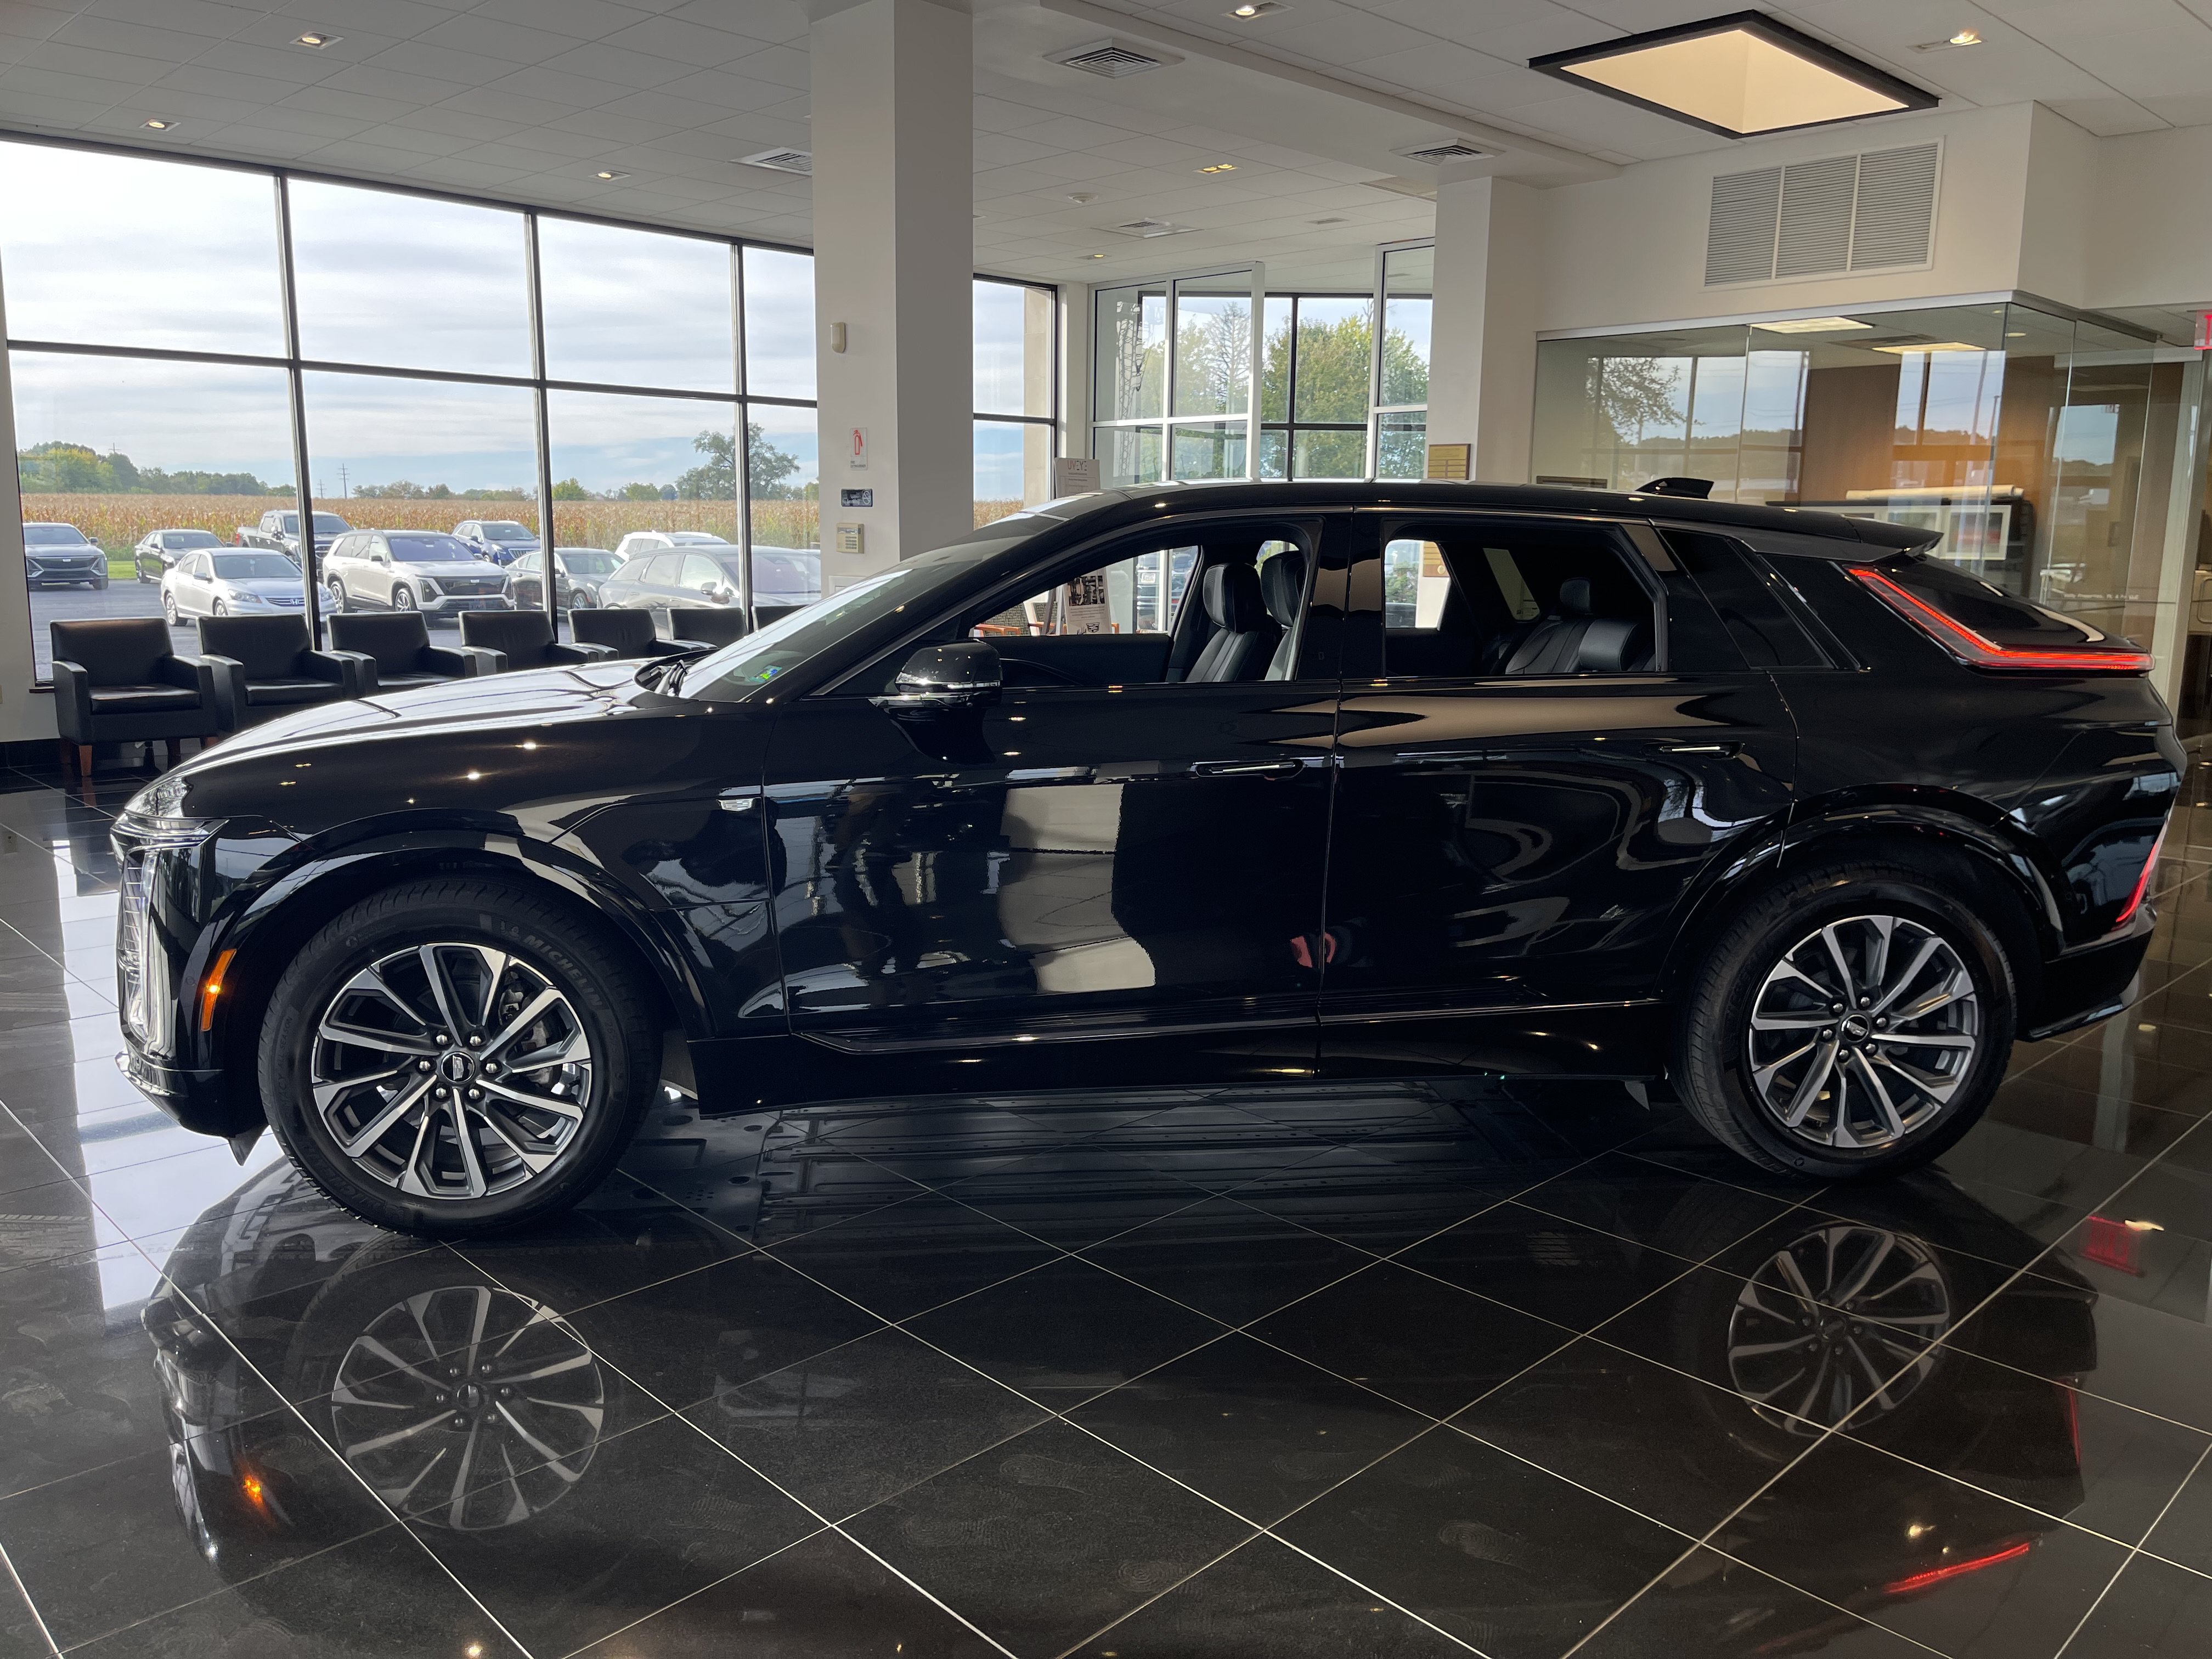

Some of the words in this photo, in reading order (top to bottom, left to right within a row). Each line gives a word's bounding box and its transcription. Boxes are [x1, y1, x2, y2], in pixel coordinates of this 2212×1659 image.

[1067, 460, 1087, 471] UVEYE
[523, 934, 603, 1007] MICHELIN
[280, 1016, 294, 1050] SEASON
